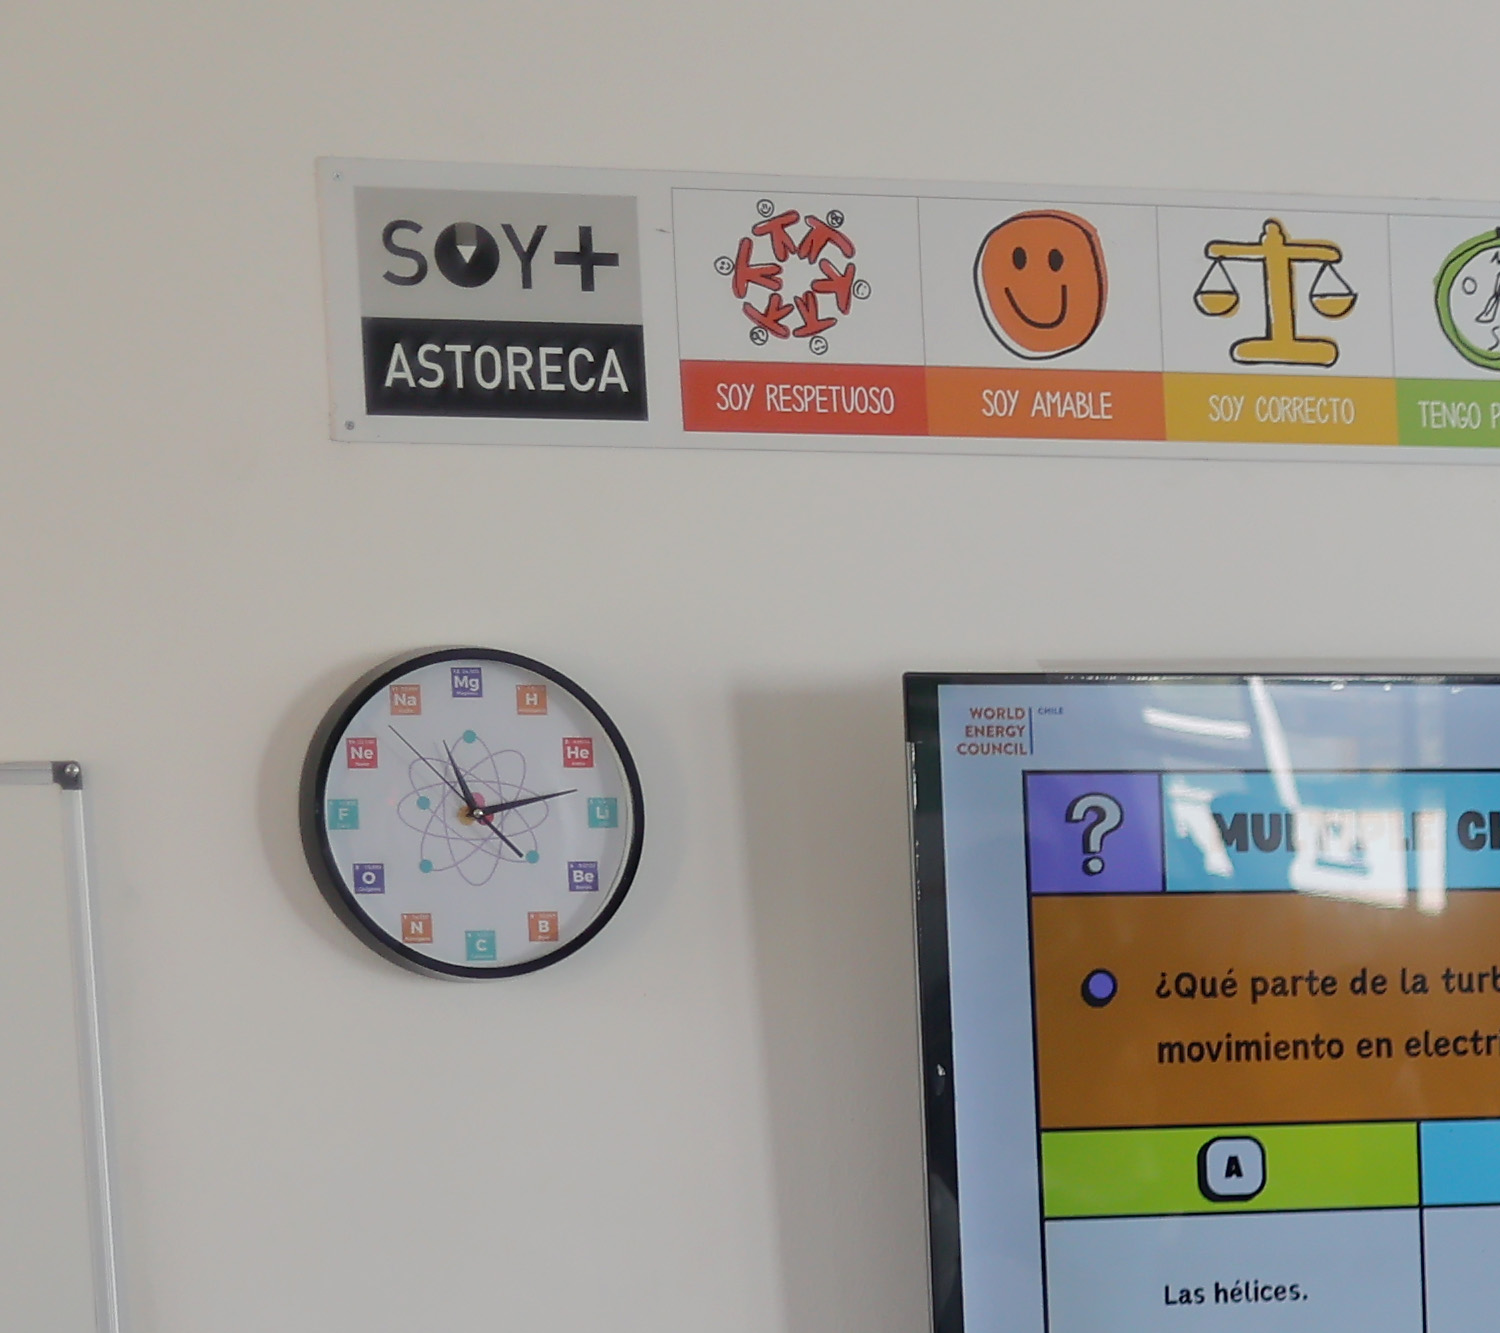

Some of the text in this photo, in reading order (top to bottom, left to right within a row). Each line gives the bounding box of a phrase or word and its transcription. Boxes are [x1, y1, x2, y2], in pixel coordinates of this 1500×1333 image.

[384, 343, 629, 393] ASTORECA
[716, 384, 895, 415] SOY RESPETUOSO
[981, 390, 1113, 420] SOY AMABLE
[1208, 395, 1355, 425] SOY CORRECTO
[1418, 400, 1481, 430] TENGO
[454, 676, 480, 691] Mg
[394, 693, 417, 706] Na
[525, 693, 538, 706] H
[969, 706, 1065, 720] WORLD CHILE
[964, 725, 1026, 738] ENERGY
[350, 746, 374, 760] Ne
[566, 746, 590, 759] He
[956, 743, 1028, 756] COUNCIL
[362, 871, 376, 885] O
[573, 869, 594, 883] Be
[410, 921, 423, 934] N
[538, 920, 550, 933] B
[476, 939, 487, 952] C
[1155, 967, 1238, 1000] ¿Qué
[1251, 968, 1338, 1004] parte
[1349, 966, 1388, 996] de
[1400, 966, 1429, 996] la
[1157, 1031, 1345, 1064] movimiento
[1356, 1035, 1394, 1061] en
[1223, 1154, 1245, 1179] A
[1163, 1277, 1309, 1306] Las hélices.
